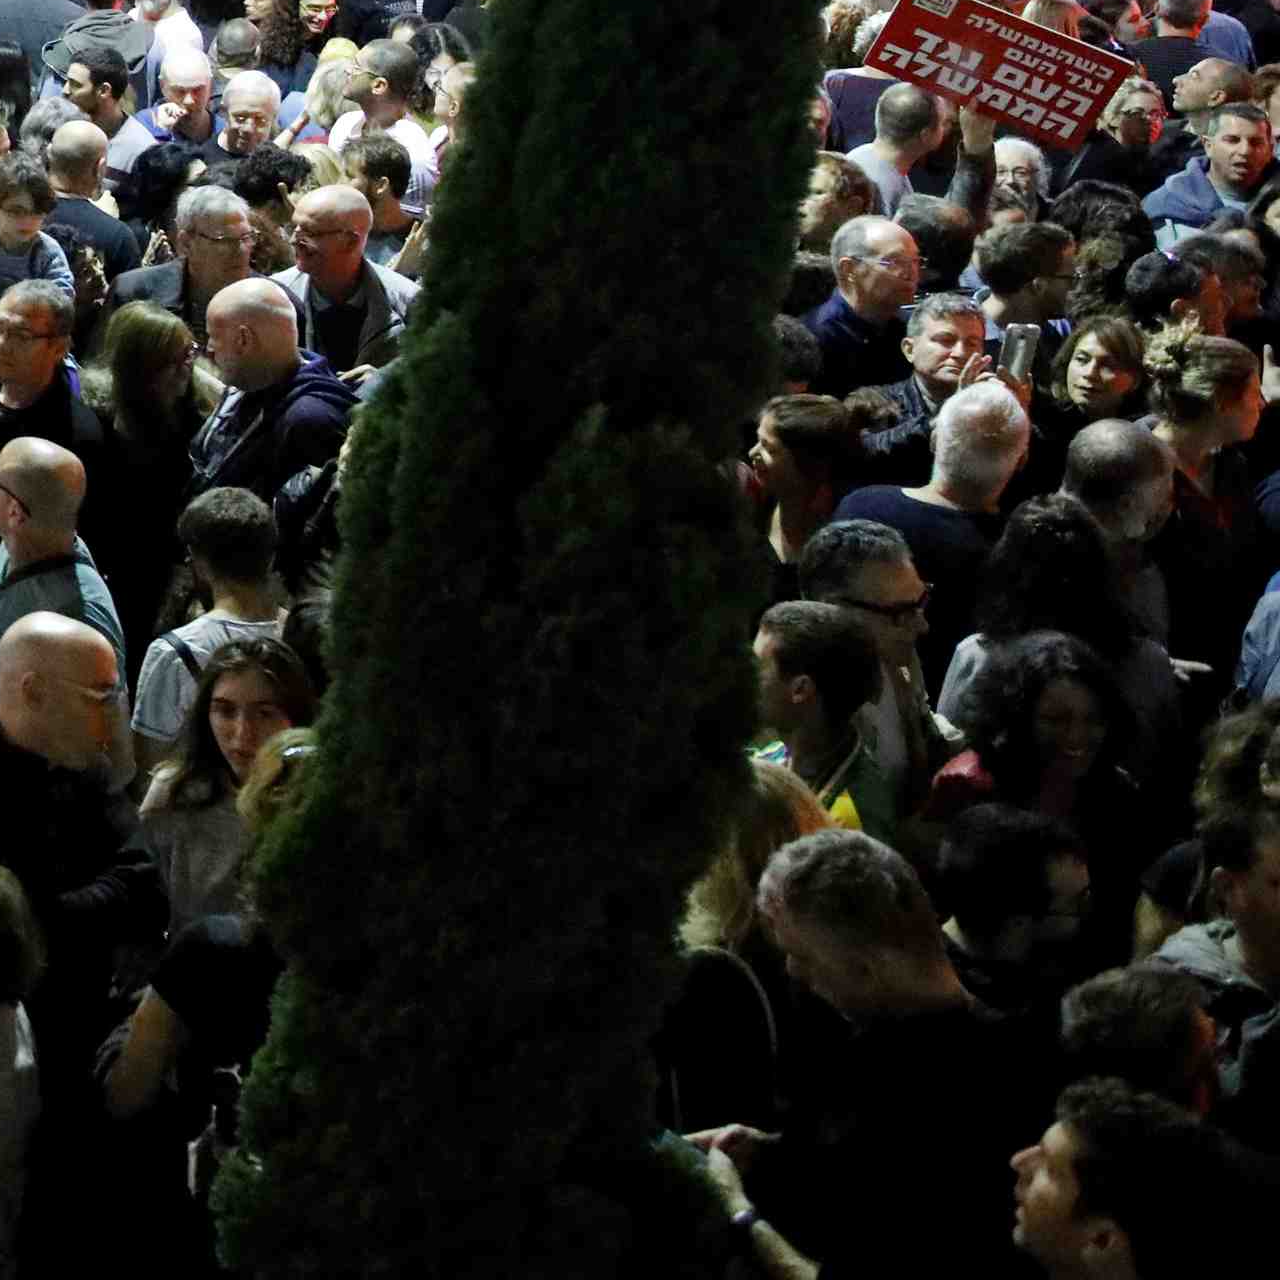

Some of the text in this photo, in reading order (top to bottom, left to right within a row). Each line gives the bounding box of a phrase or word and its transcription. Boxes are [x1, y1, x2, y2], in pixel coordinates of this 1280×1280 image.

[913, 27, 1094, 117] העם נגד
[965, 12, 1116, 81] כשהממשלה
[1003, 47, 1105, 96] נגד העם
[878, 43, 1080, 140] הממשלה
